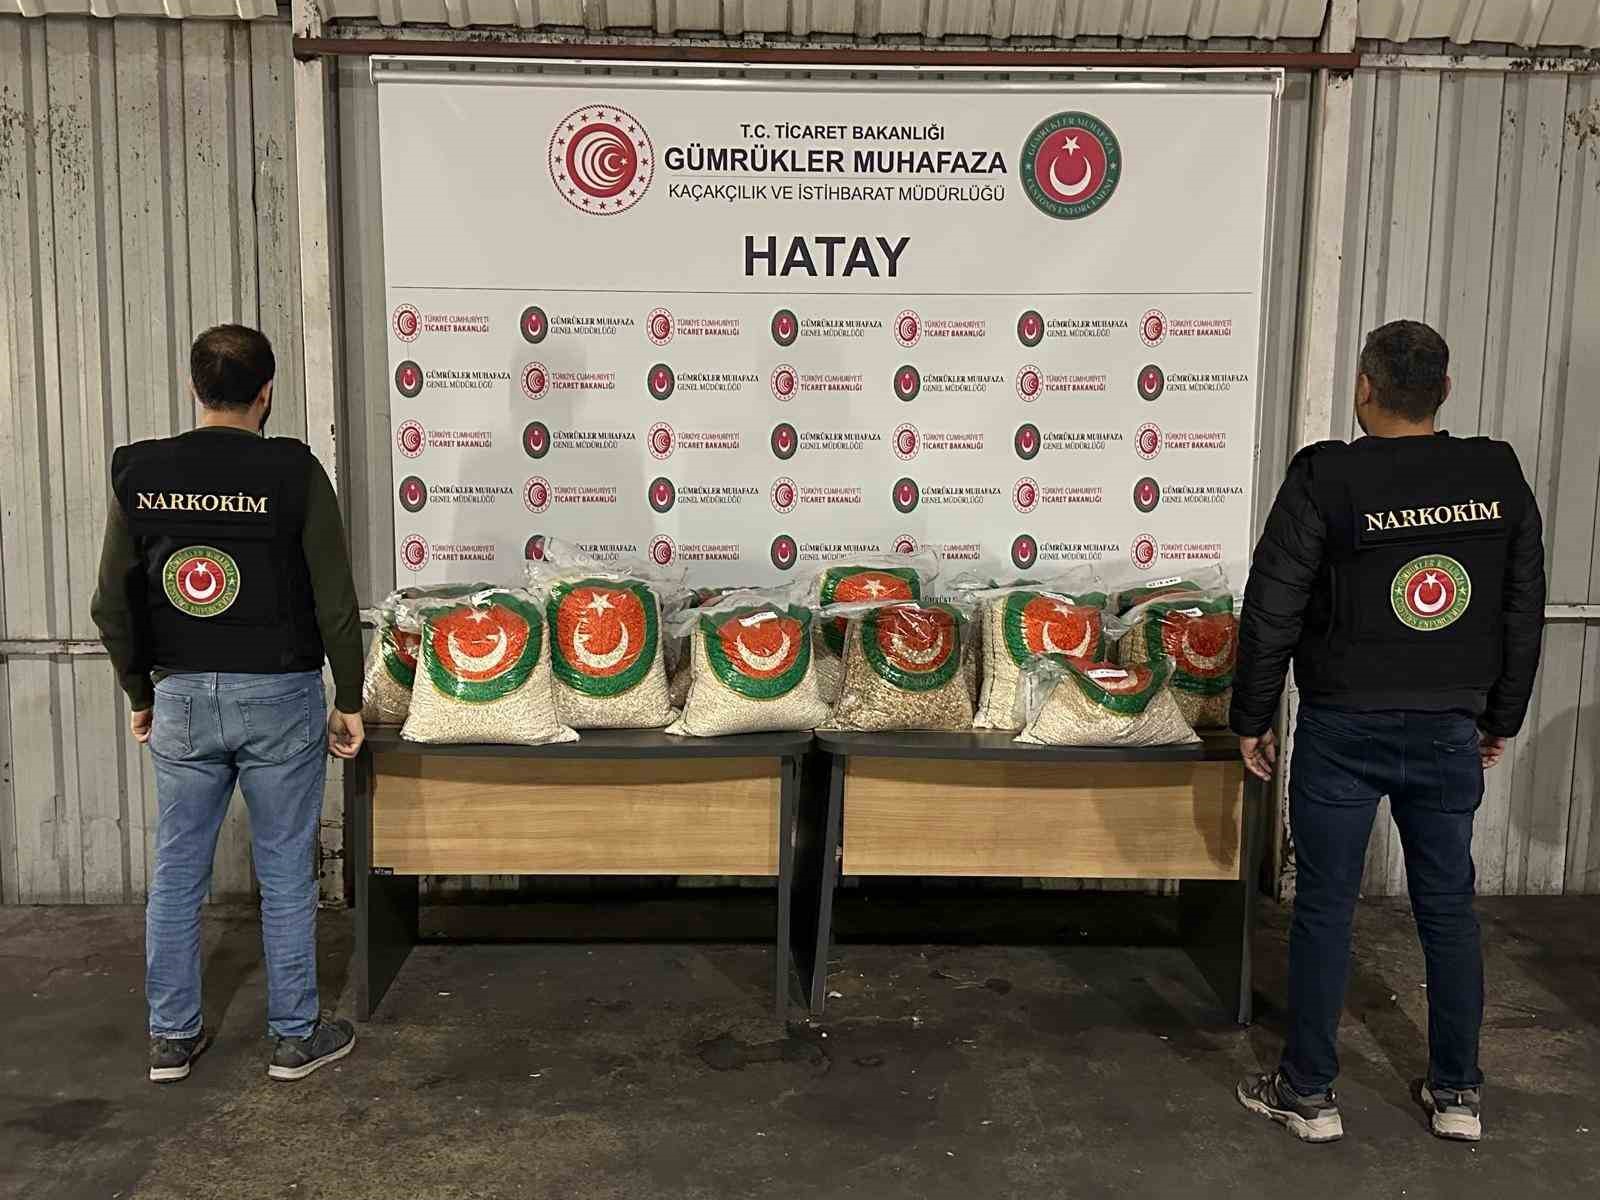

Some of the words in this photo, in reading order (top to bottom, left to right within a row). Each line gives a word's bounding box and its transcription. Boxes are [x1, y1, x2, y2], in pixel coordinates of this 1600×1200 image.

[740, 124, 770, 138] T.C.
[774, 121, 847, 139] TİCARET
[853, 123, 945, 140] BAKANLIĞI
[664, 144, 846, 173] GÜMRÜKLER
[853, 149, 1008, 174] MUHAFAZA
[668, 183, 768, 203] KAÇAKÇILIK
[771, 185, 793, 201] VE
[798, 182, 897, 201] İSTİHBARAT
[900, 182, 1006, 202] MÜDÜRLÜĞÜ
[744, 235, 912, 278] HATAY
[550, 315, 595, 326] GÜMRÜKLER
[596, 316, 635, 326] MUHAFAZA
[800, 318, 845, 328] GÜMRÜKLER
[845, 319, 883, 328] MUHAFAZA
[1046, 319, 1091, 329] GÜMRÜKLER
[1091, 320, 1128, 329] MUHAFAZA
[425, 369, 471, 380] GÜMRÜKLER
[471, 370, 511, 380] MUHAFAZA
[676, 372, 721, 382] GÜMRÜKLER
[721, 373, 759, 382] MUHAFAZA
[922, 374, 966, 383] GÜMRÜKLER
[966, 375, 1004, 383] MUHAFAZA
[1166, 373, 1210, 383] GÜMRÜKLER
[1210, 374, 1249, 383] MUHAFAZA
[552, 430, 597, 440] GÜMRÜKLER
[597, 431, 636, 440] MUHAFAZA
[799, 431, 843, 441] GÜMRÜKLER
[843, 432, 881, 441] MUHAFAZA
[1043, 431, 1086, 441] GÜMRÜKLER
[1086, 432, 1123, 441] MUHAFAZA
[429, 484, 474, 495] GÜMRÜKLER
[474, 485, 514, 495] MUHAFAZA
[677, 486, 721, 495] GÜMRÜKLER
[721, 487, 760, 495] MUHAFAZA
[921, 486, 964, 496] GÜMRÜKLER
[964, 487, 1001, 496] MUHAFAZA
[1162, 485, 1205, 495] GÜMRÜKLER
[1206, 486, 1244, 495] MUHAFAZA
[136, 492, 268, 514] NARKOKİM
[1364, 499, 1502, 531] NARKOKİM
[599, 544, 638, 552] MUHAFAZA
[799, 543, 843, 552] GÜMRÜKLER
[843, 544, 881, 552] MUHAFAZA
[1039, 542, 1082, 552] GÜMRÜKLER
[1082, 543, 1120, 552] MUHAFAZA
